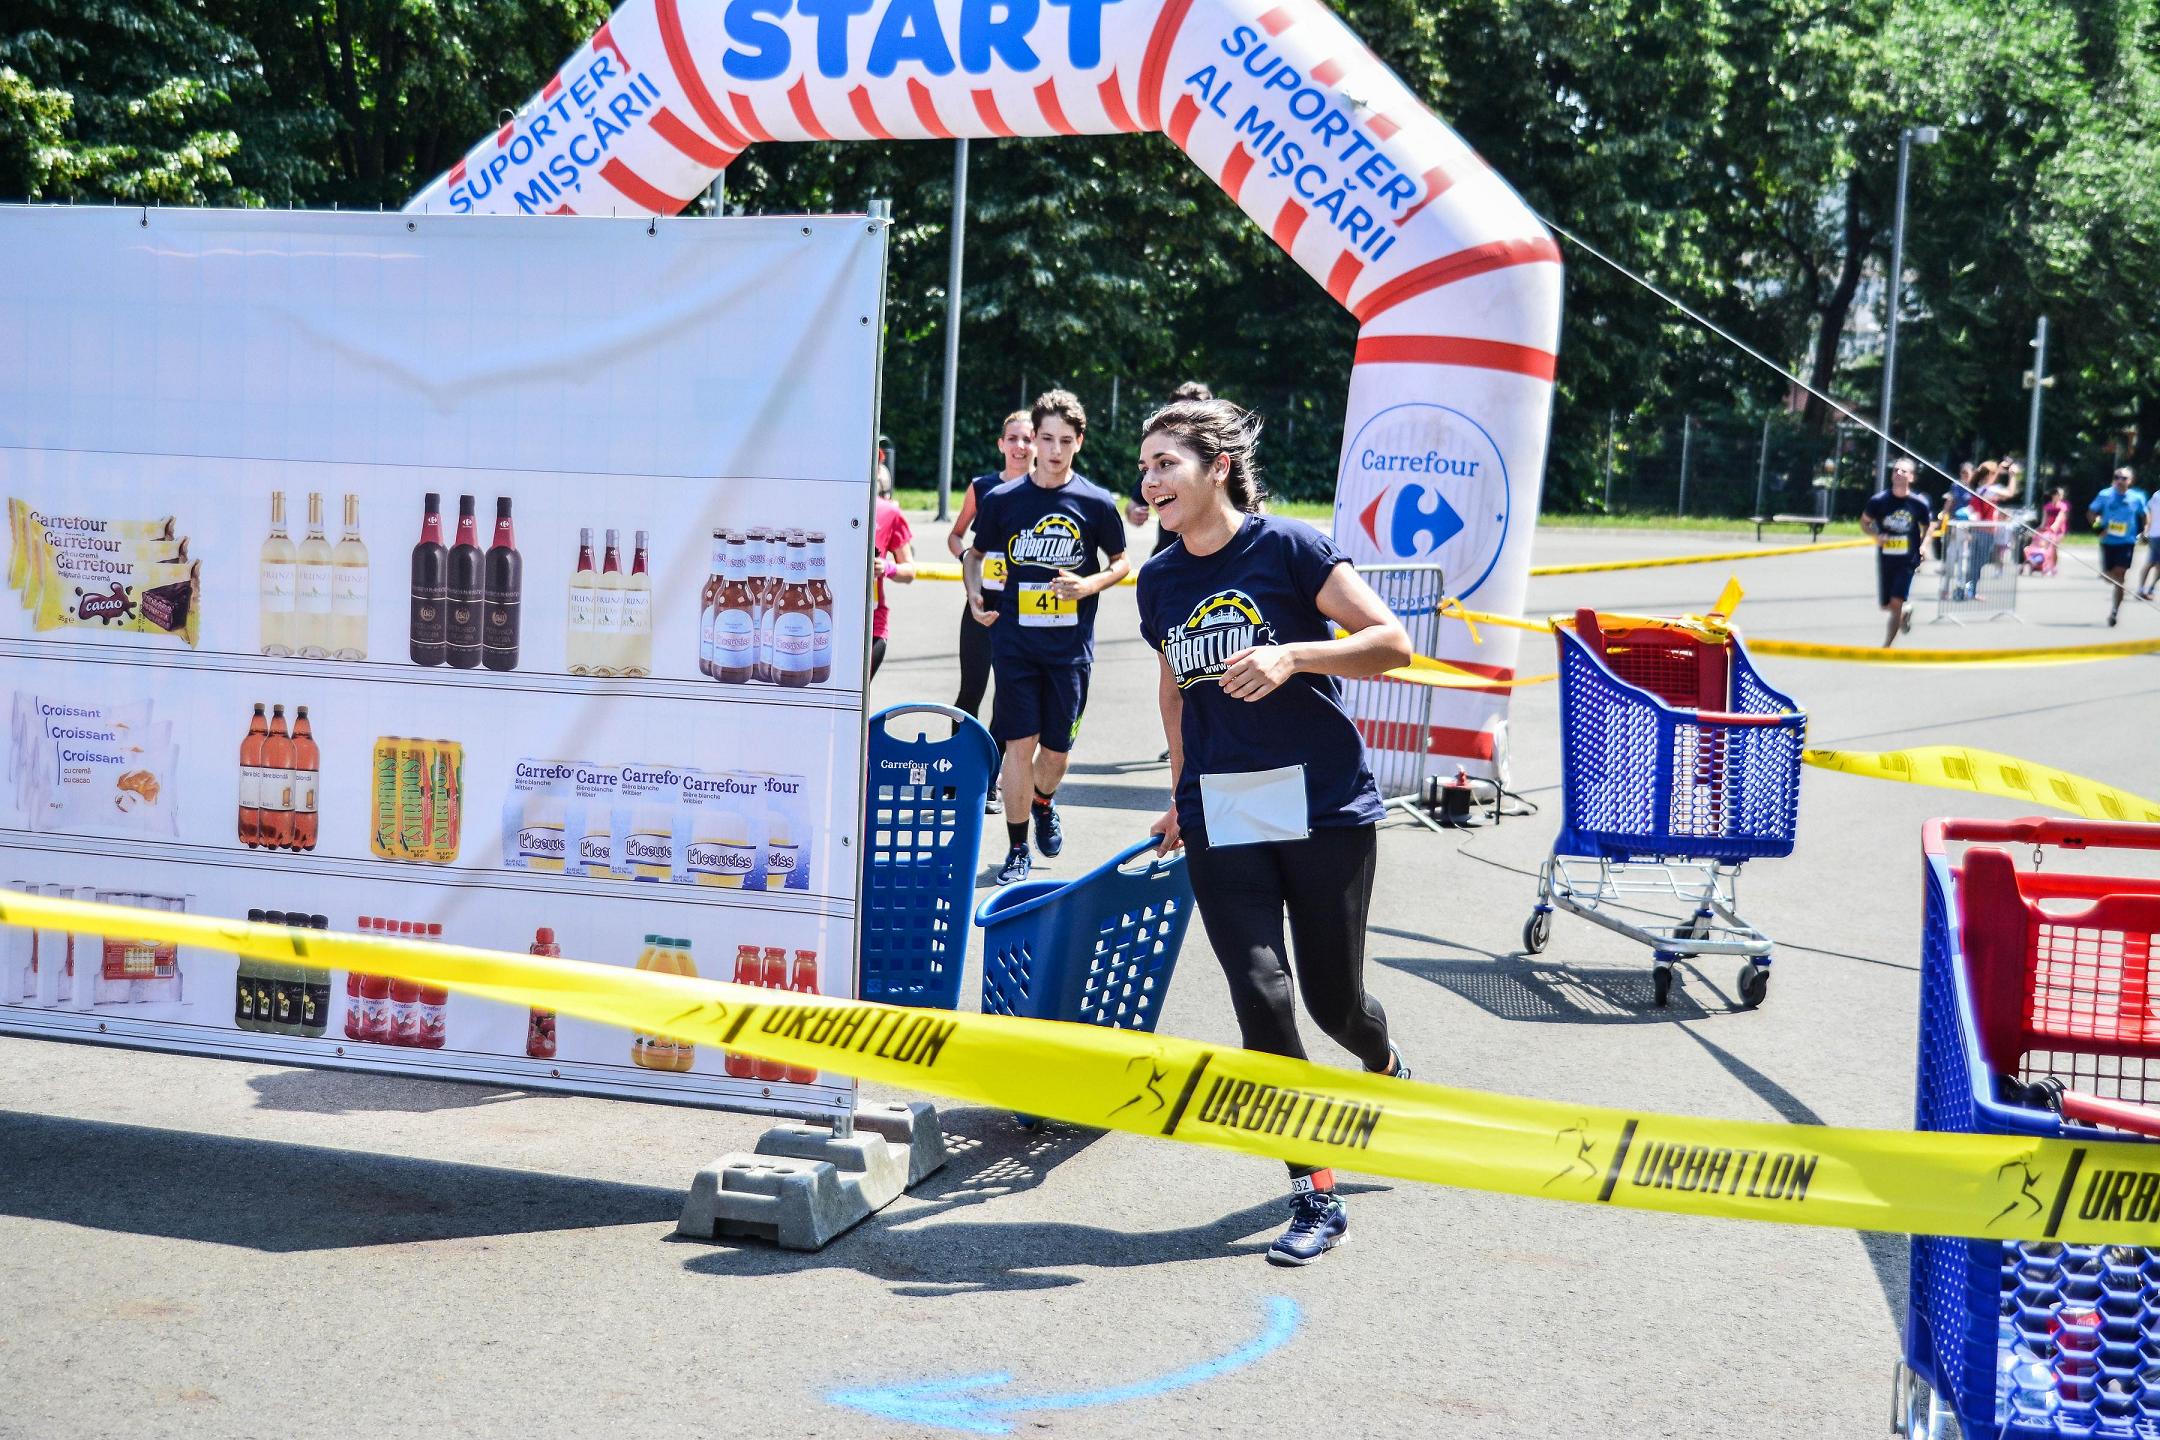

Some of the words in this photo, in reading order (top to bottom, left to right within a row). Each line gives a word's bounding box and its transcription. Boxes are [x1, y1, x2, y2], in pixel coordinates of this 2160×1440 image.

[722, 0, 1122, 81] START
[1220, 26, 1417, 211] SUPORTER
[448, 52, 618, 213] SUPORTER
[1185, 64, 1227, 119] AL
[1234, 105, 1396, 263] MIȘCĂRII
[1361, 449, 1479, 477] Carrefour
[30, 510, 107, 532] Carrefour
[44, 531, 121, 552] Carrefour
[1020, 529, 1035, 539] 5K
[1012, 537, 1076, 557] URBATLON
[56, 553, 133, 575] Carrefour
[85, 599, 123, 611] cacao
[1036, 593, 1058, 611] 41
[1168, 624, 1187, 644] 5K
[42, 704, 102, 718] Croissant
[52, 726, 116, 742] Croissant
[62, 749, 126, 765] Croissant
[881, 759, 929, 769] Carrefour
[516, 763, 574, 779] Carrefo
[576, 769, 618, 786] Carre
[622, 767, 681, 785] Carrefo
[683, 776, 757, 795] Carrefour
[764, 777, 800, 793] four
[762, 1004, 959, 1067] URBATLON
[1199, 1075, 1384, 1150] URBATLON
[1632, 1141, 1819, 1202] URBATLON
